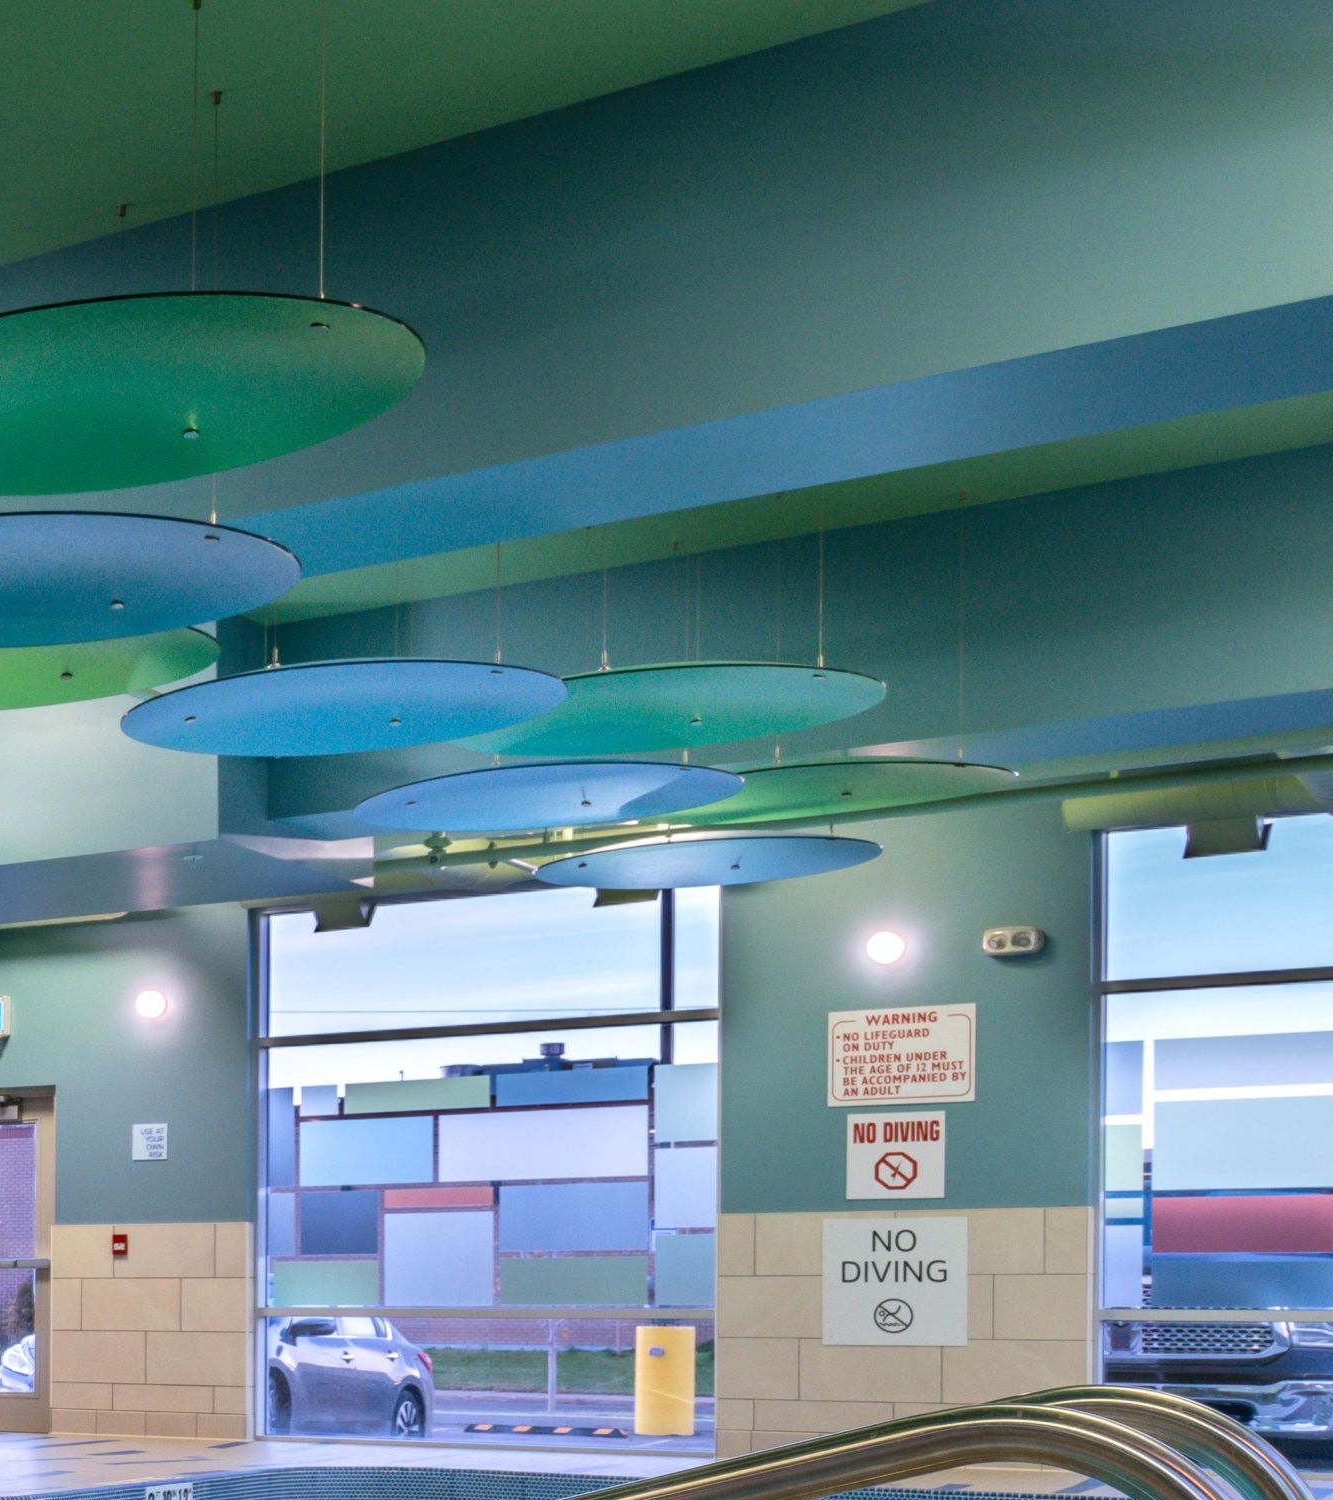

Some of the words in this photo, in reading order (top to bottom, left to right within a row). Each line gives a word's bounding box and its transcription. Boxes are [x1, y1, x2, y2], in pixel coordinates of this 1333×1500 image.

[866, 1012, 937, 1026] WARNING
[843, 1032, 859, 1041] NO
[865, 1028, 929, 1040] LIFEGUARD
[843, 1043, 859, 1052] ON
[865, 1041, 894, 1051] DUTY
[843, 1053, 901, 1064] CHILDREN
[907, 1051, 947, 1062] UNDER
[844, 1066, 865, 1075] THE
[870, 1065, 891, 1074] AGE
[897, 1064, 911, 1072] OF
[917, 1063, 926, 1072] 12
[932, 1061, 964, 1070] MUST
[843, 1077, 857, 1085] BE
[862, 1073, 946, 1085] ACCOMPANIED
[952, 1072, 966, 1080] BY
[843, 1088, 858, 1096] AN
[863, 1086, 900, 1095] ADULT
[853, 1123, 876, 1143] NO
[884, 1120, 939, 1142] DIVING
[872, 1230, 917, 1252] NO
[842, 1260, 947, 1282] DIVING
